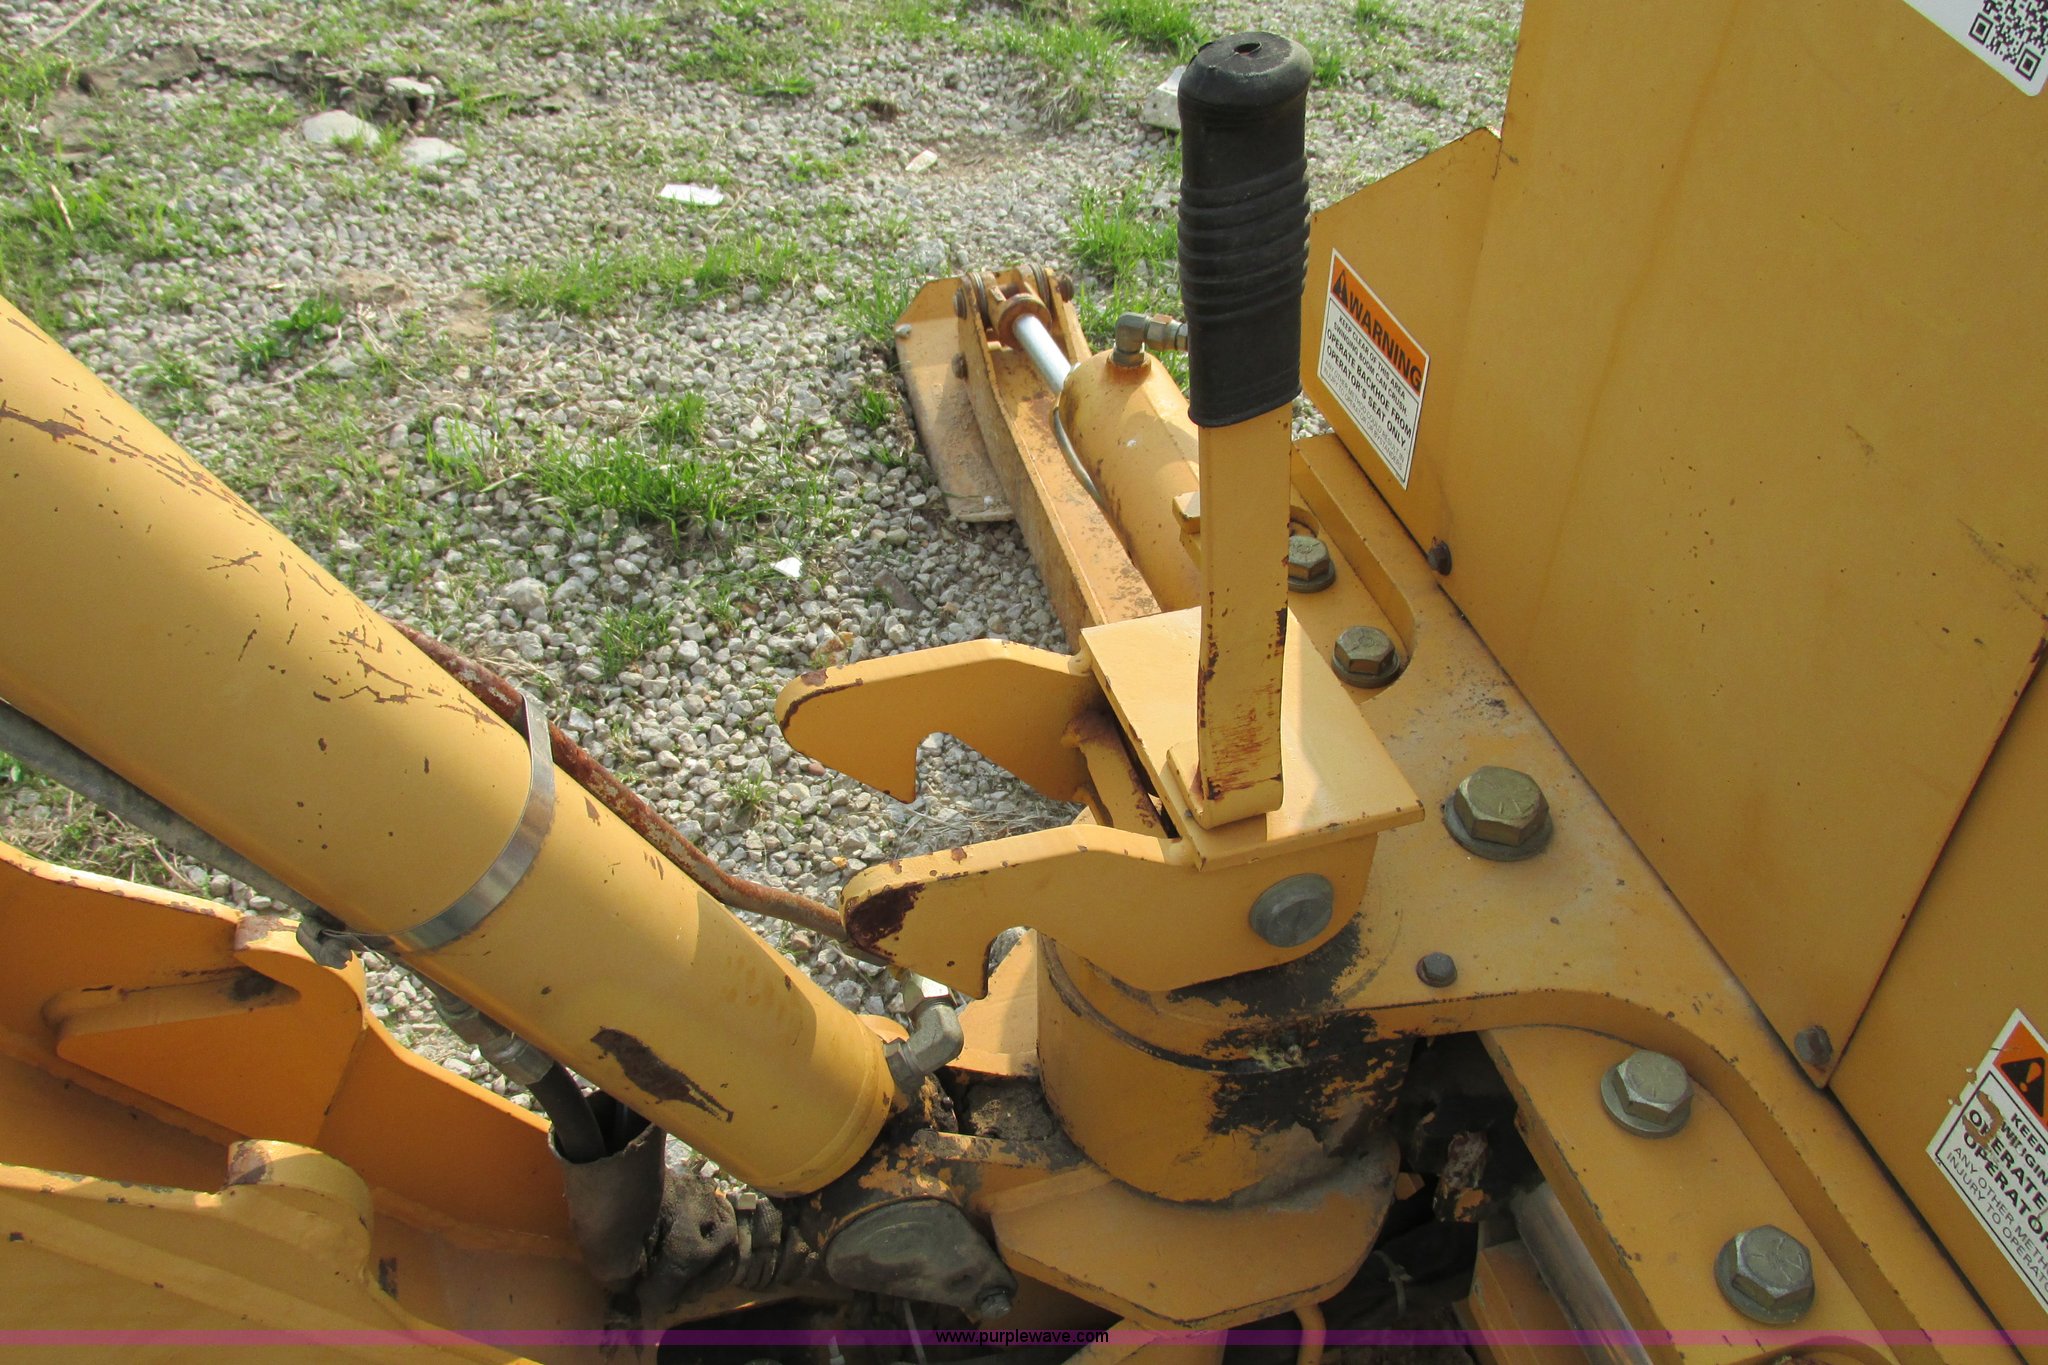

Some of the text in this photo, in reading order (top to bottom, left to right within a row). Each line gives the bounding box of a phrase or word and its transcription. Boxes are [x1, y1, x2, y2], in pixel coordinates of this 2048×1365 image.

[1327, 329, 1412, 439] OPERATE BACKHOE FROM
[1334, 321, 1359, 355] SWINGING
[1359, 352, 1375, 375] BOOM
[1375, 373, 1388, 391] CAN
[1339, 315, 1406, 400] KEEP CLEAR OF THIS AREA
[1350, 291, 1422, 393] WARNING
[1327, 344, 1406, 451] OPERATOR'S SEAT ONLY.
[2011, 1113, 2046, 1155] KEEP
[1947, 1152, 1986, 1201] INJURY
[1986, 1203, 2002, 1225] TO
[1953, 1147, 2048, 1275] ANY OTHER METH
